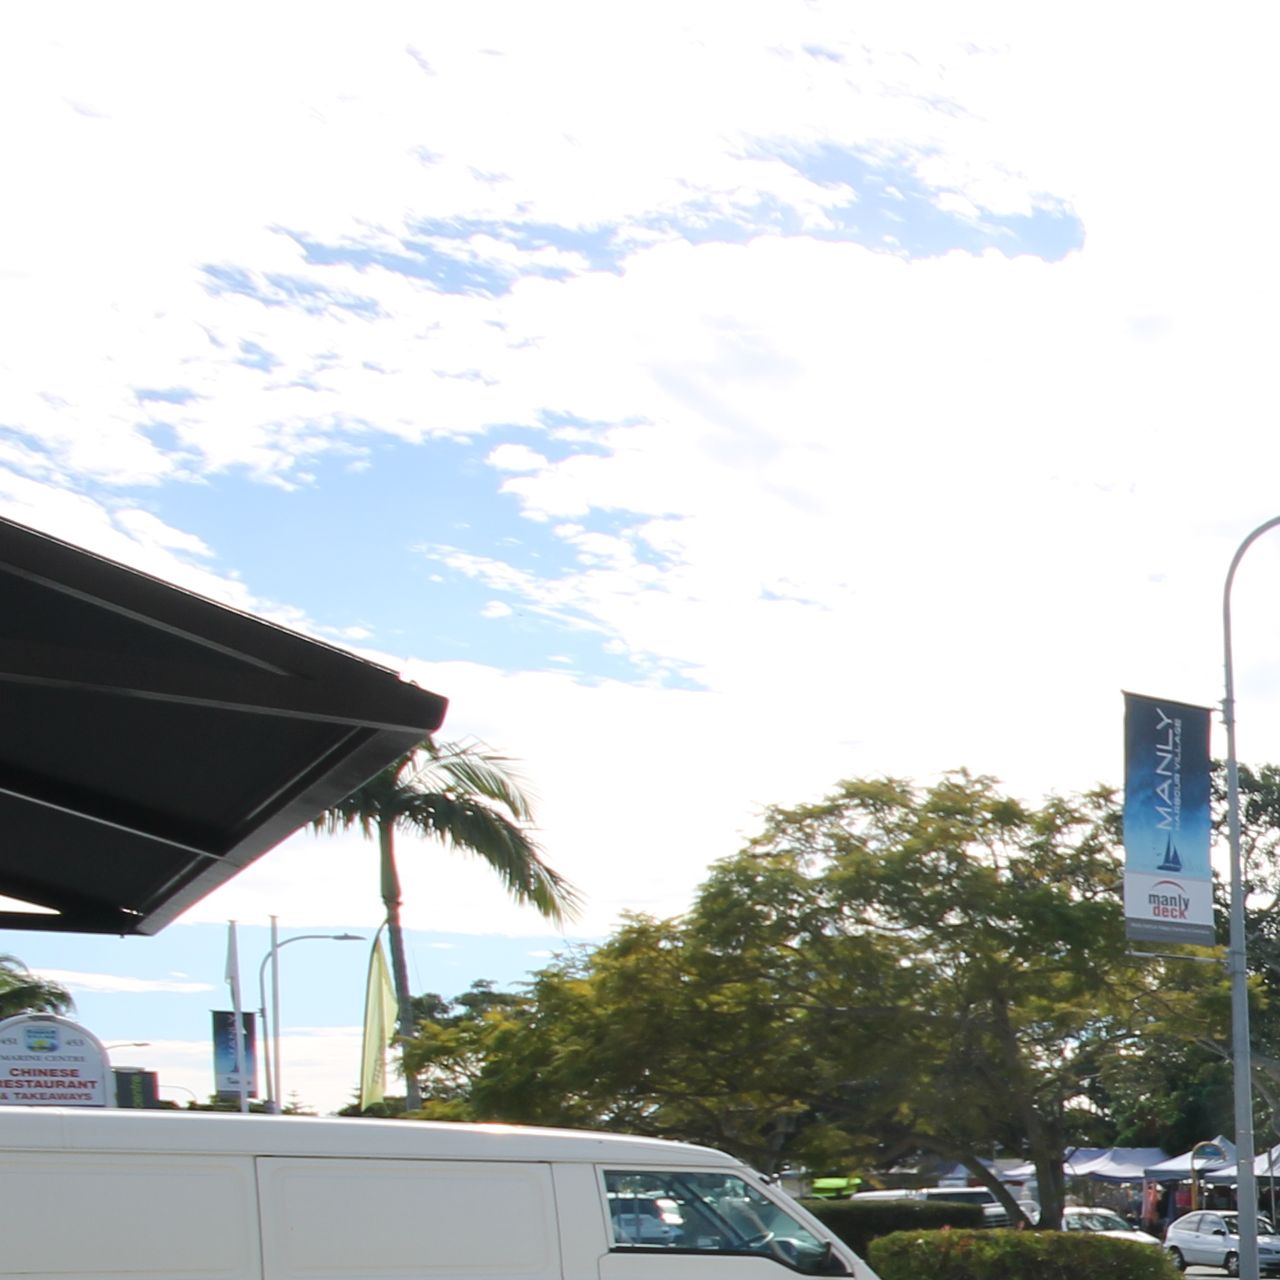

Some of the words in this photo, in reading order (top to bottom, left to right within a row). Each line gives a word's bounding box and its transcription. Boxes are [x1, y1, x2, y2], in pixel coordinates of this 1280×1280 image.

[1173, 718, 1182, 770] VILLAGE
[1155, 707, 1173, 830] MANLY
[1148, 893, 1190, 911] manly
[1152, 904, 1187, 919] deck
[9, 1068, 80, 1077] CHINESE
[13, 1091, 93, 1101] TAKEAWAYS
